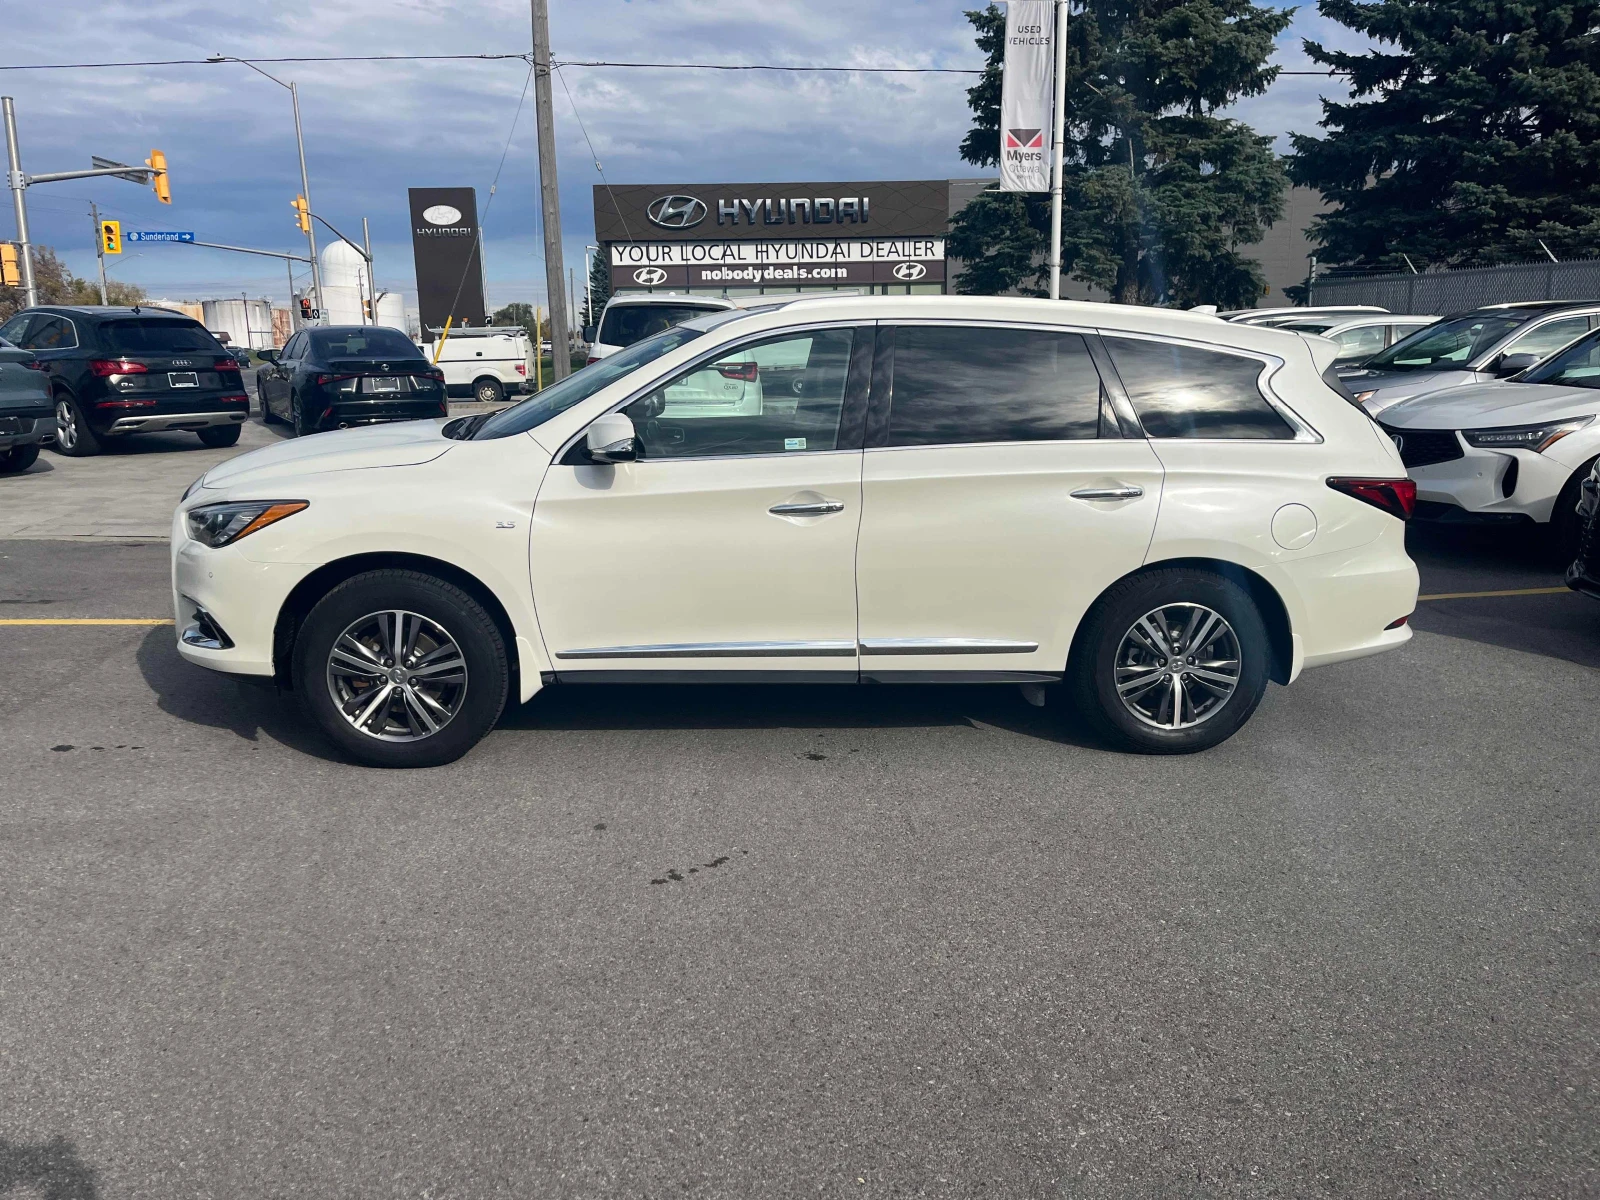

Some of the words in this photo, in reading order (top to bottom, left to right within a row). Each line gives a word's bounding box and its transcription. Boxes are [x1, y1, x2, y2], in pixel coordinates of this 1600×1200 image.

[1017, 25, 1042, 34] USED
[1008, 37, 1050, 46] VEHICLES
[1006, 149, 1042, 164] Myers
[1008, 163, 1040, 173] Ottawa
[718, 197, 870, 224] HYUNDAI
[140, 232, 179, 241] Sunderland
[416, 227, 472, 237] HYUNDAI
[614, 245, 673, 262] YOUR
[680, 244, 747, 261] LOCAL
[755, 242, 851, 260] HYUNDAI
[860, 240, 936, 258] DEALER
[701, 265, 848, 283] nobodydeals.com
